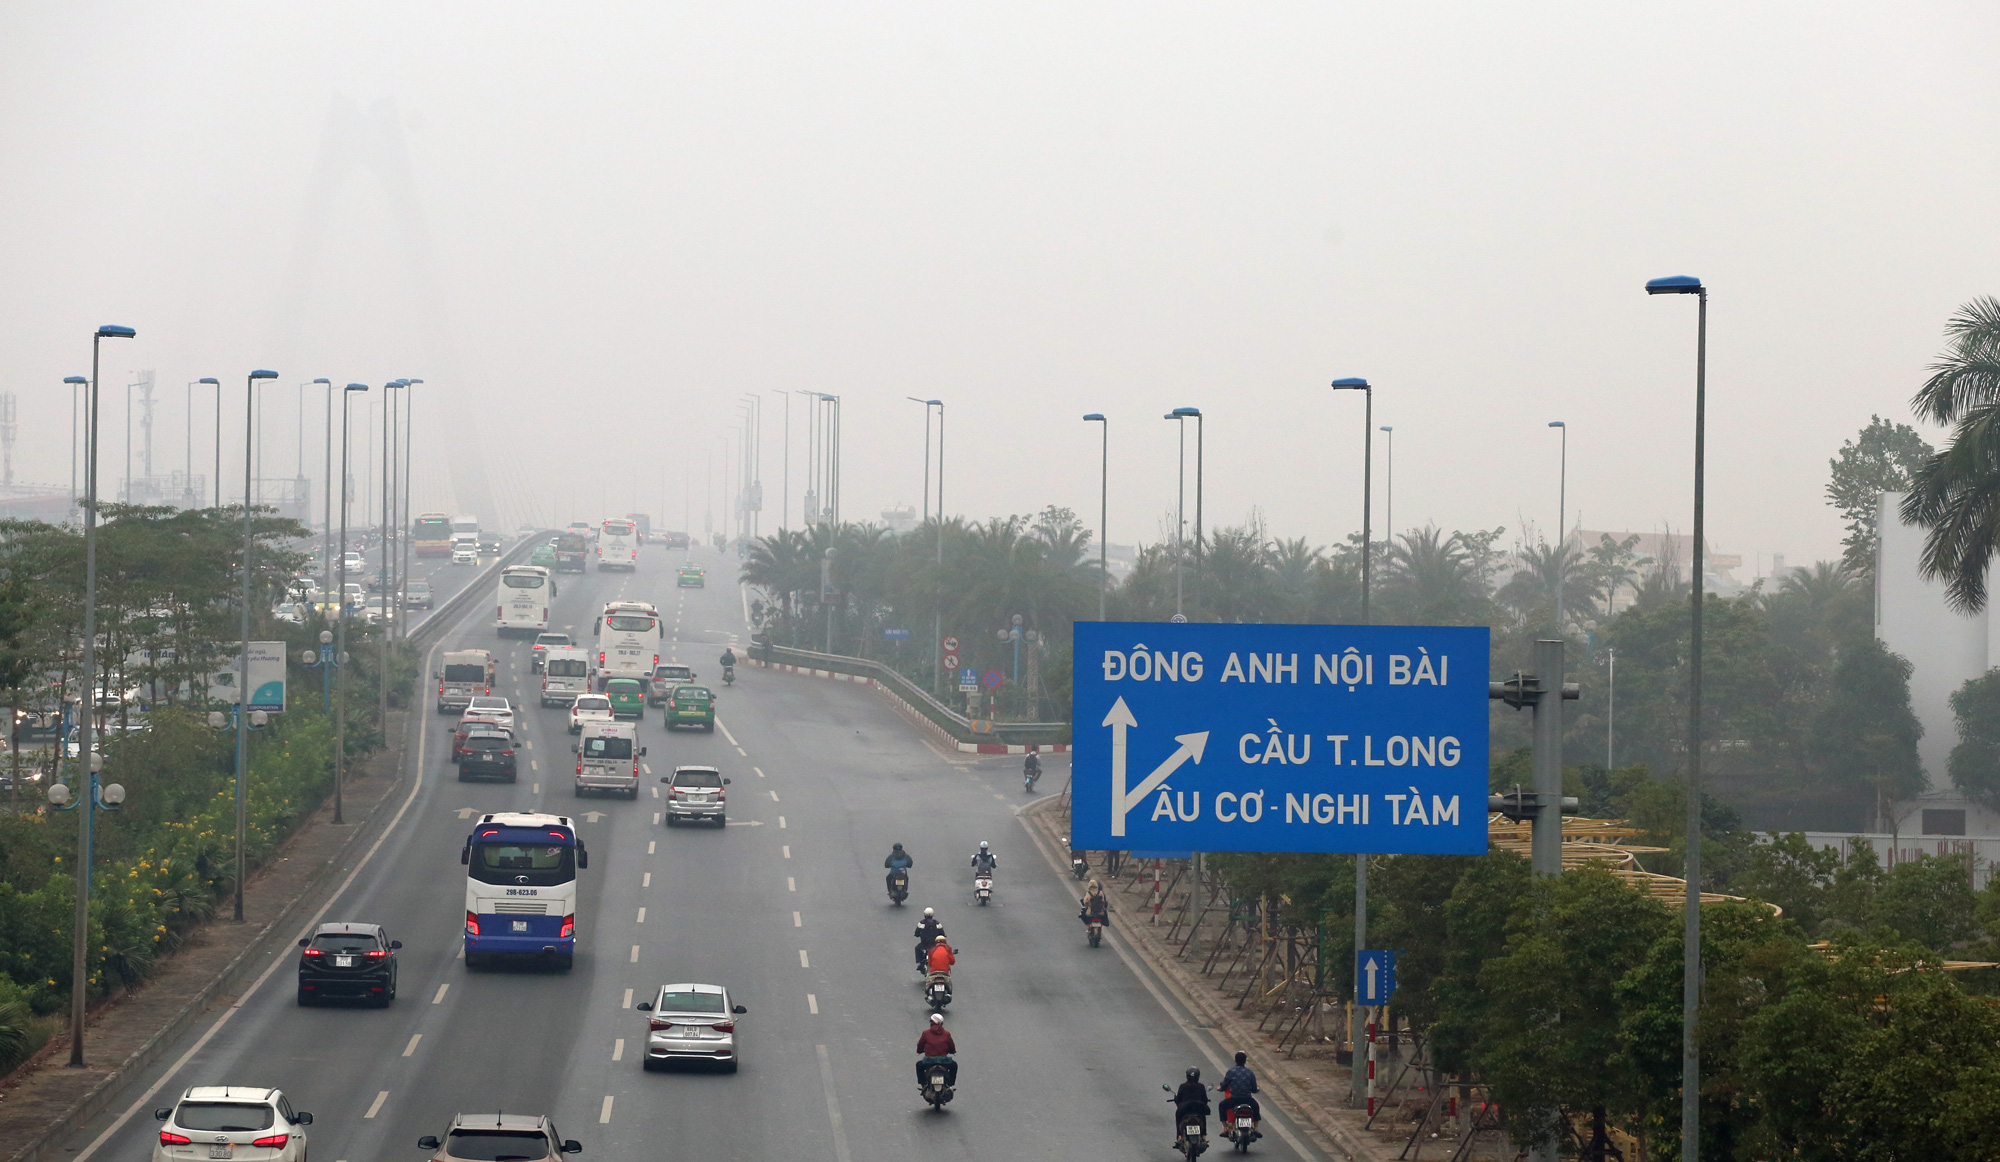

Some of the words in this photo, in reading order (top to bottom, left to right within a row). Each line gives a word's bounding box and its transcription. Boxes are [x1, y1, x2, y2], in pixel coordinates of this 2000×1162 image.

[1102, 643, 1204, 682] ĐÔNG
[1220, 652, 1298, 684] ANH
[1314, 646, 1373, 692] NỘI
[1389, 647, 1448, 686] BÀI
[1239, 718, 1311, 765] CẦU
[1327, 734, 1461, 767] T.LONG
[1151, 783, 1200, 822] ÂU
[1215, 788, 1265, 823] CƠ
[1285, 793, 1369, 825] NGHI
[1385, 786, 1459, 826] TÀM
